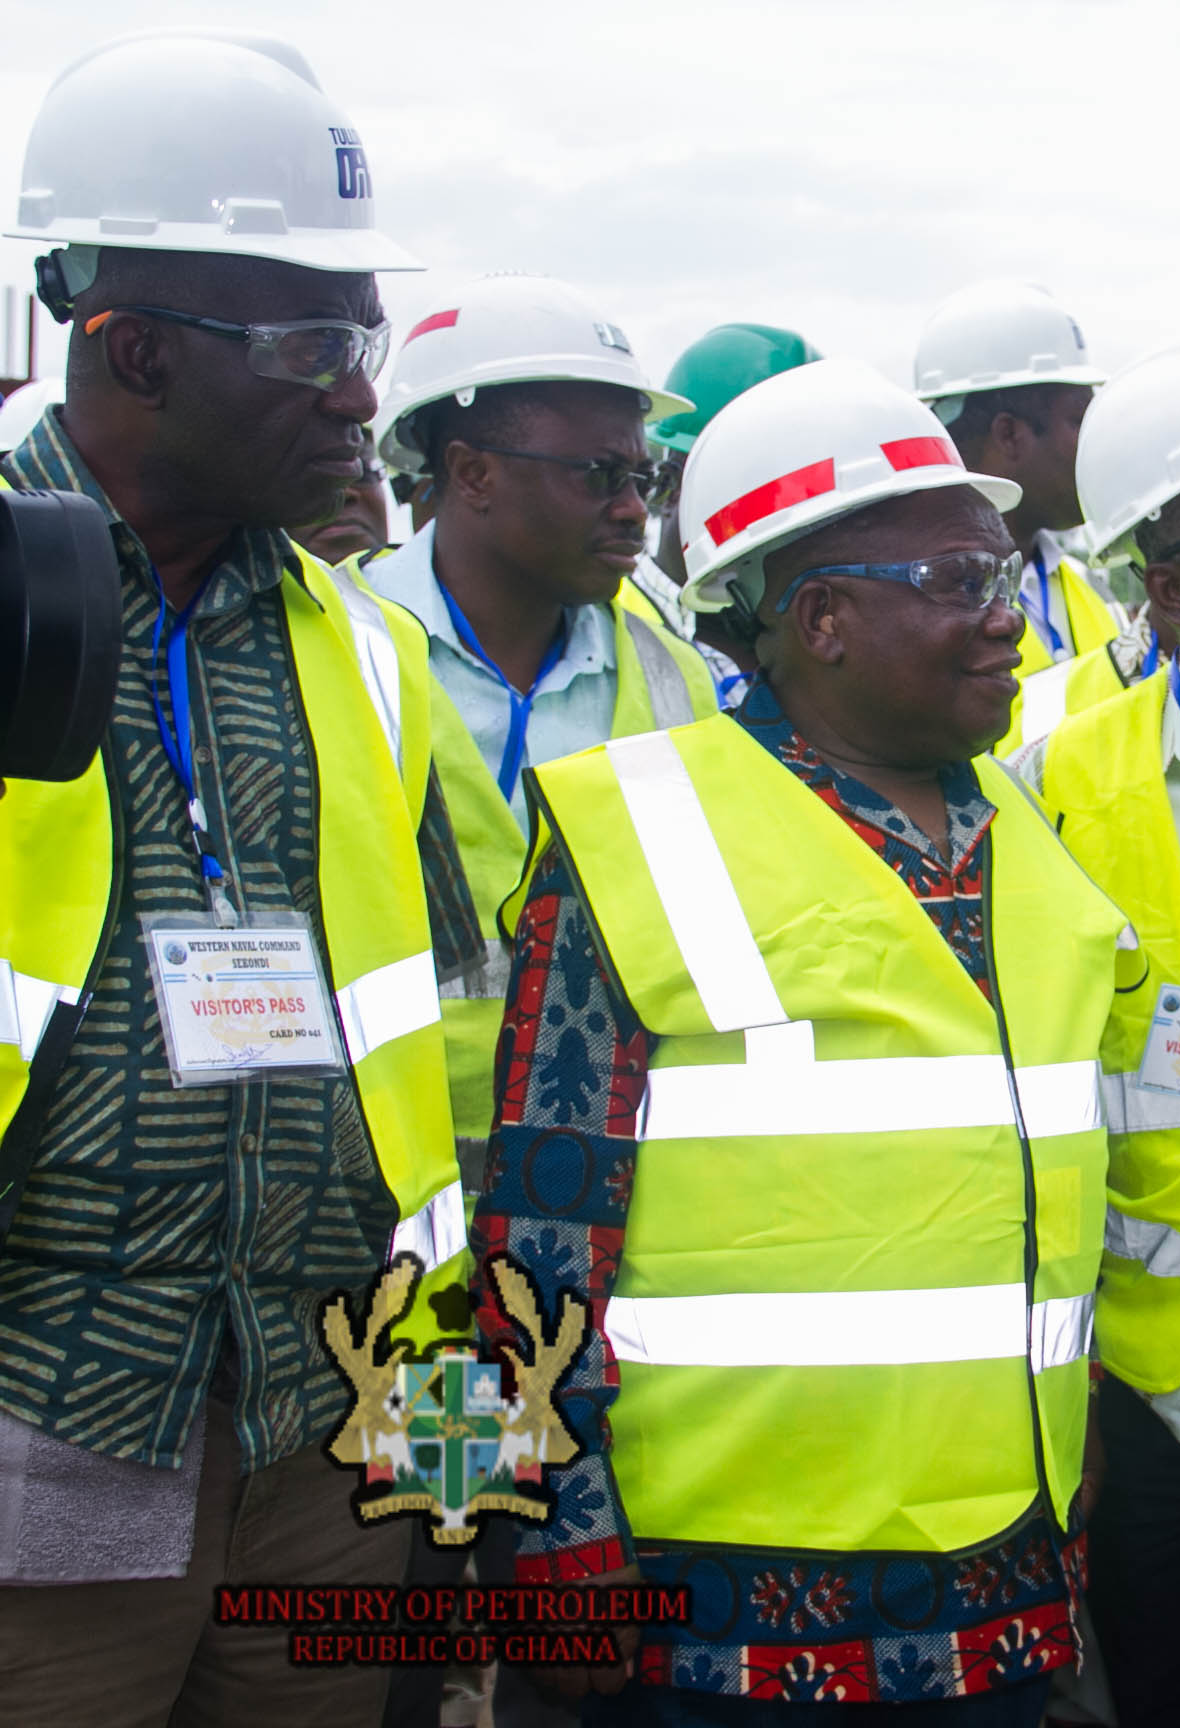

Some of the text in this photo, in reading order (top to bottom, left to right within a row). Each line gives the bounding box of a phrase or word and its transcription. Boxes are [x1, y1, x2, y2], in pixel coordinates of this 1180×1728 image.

[188, 940, 301, 952] WESTERN NAVAL COMMAND
[232, 958, 270, 969] SEKONDI
[191, 997, 305, 1017] VISITOR'S PASS
[270, 1029, 293, 1038] CARD
[295, 1029, 307, 1038] NO
